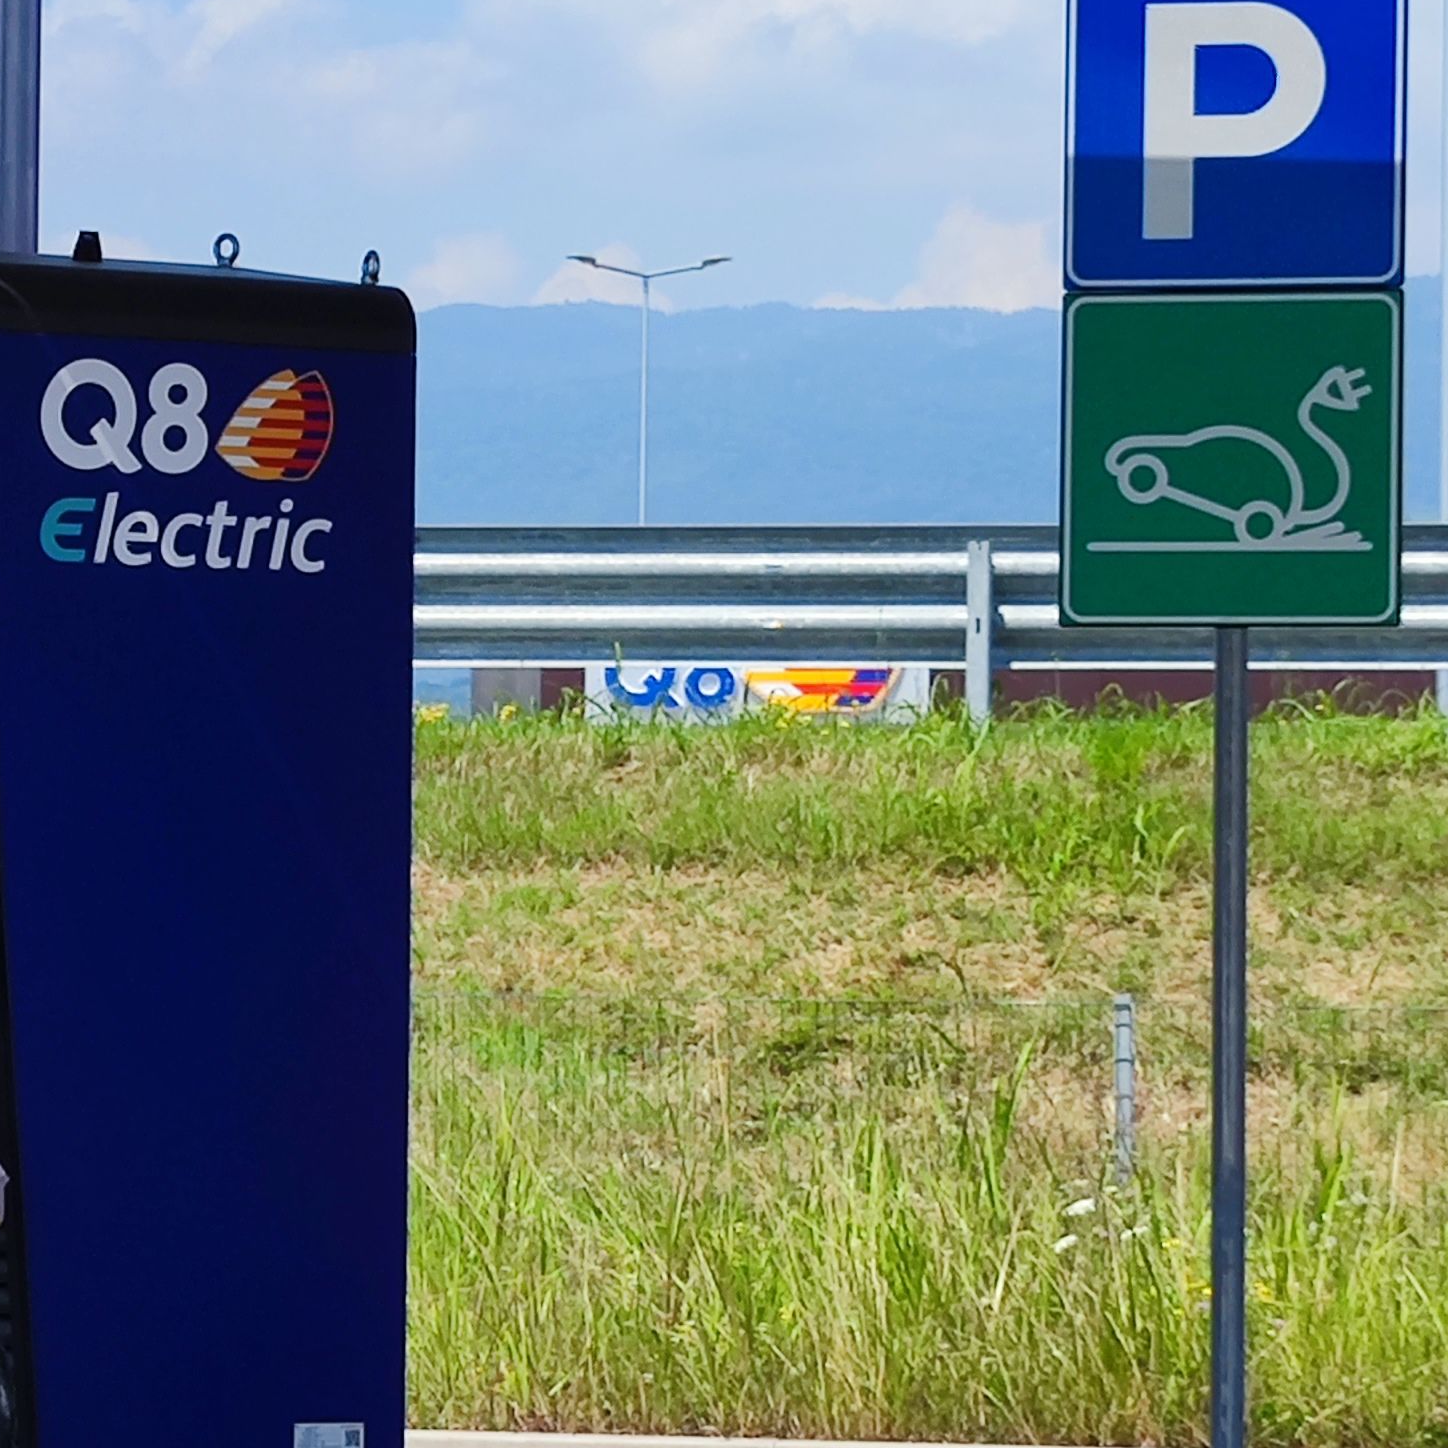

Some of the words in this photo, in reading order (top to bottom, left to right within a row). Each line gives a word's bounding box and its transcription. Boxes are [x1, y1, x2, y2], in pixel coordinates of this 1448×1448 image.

[1142, 1, 1326, 240] P
[40, 358, 209, 474] Q8
[40, 491, 333, 573] Electric
